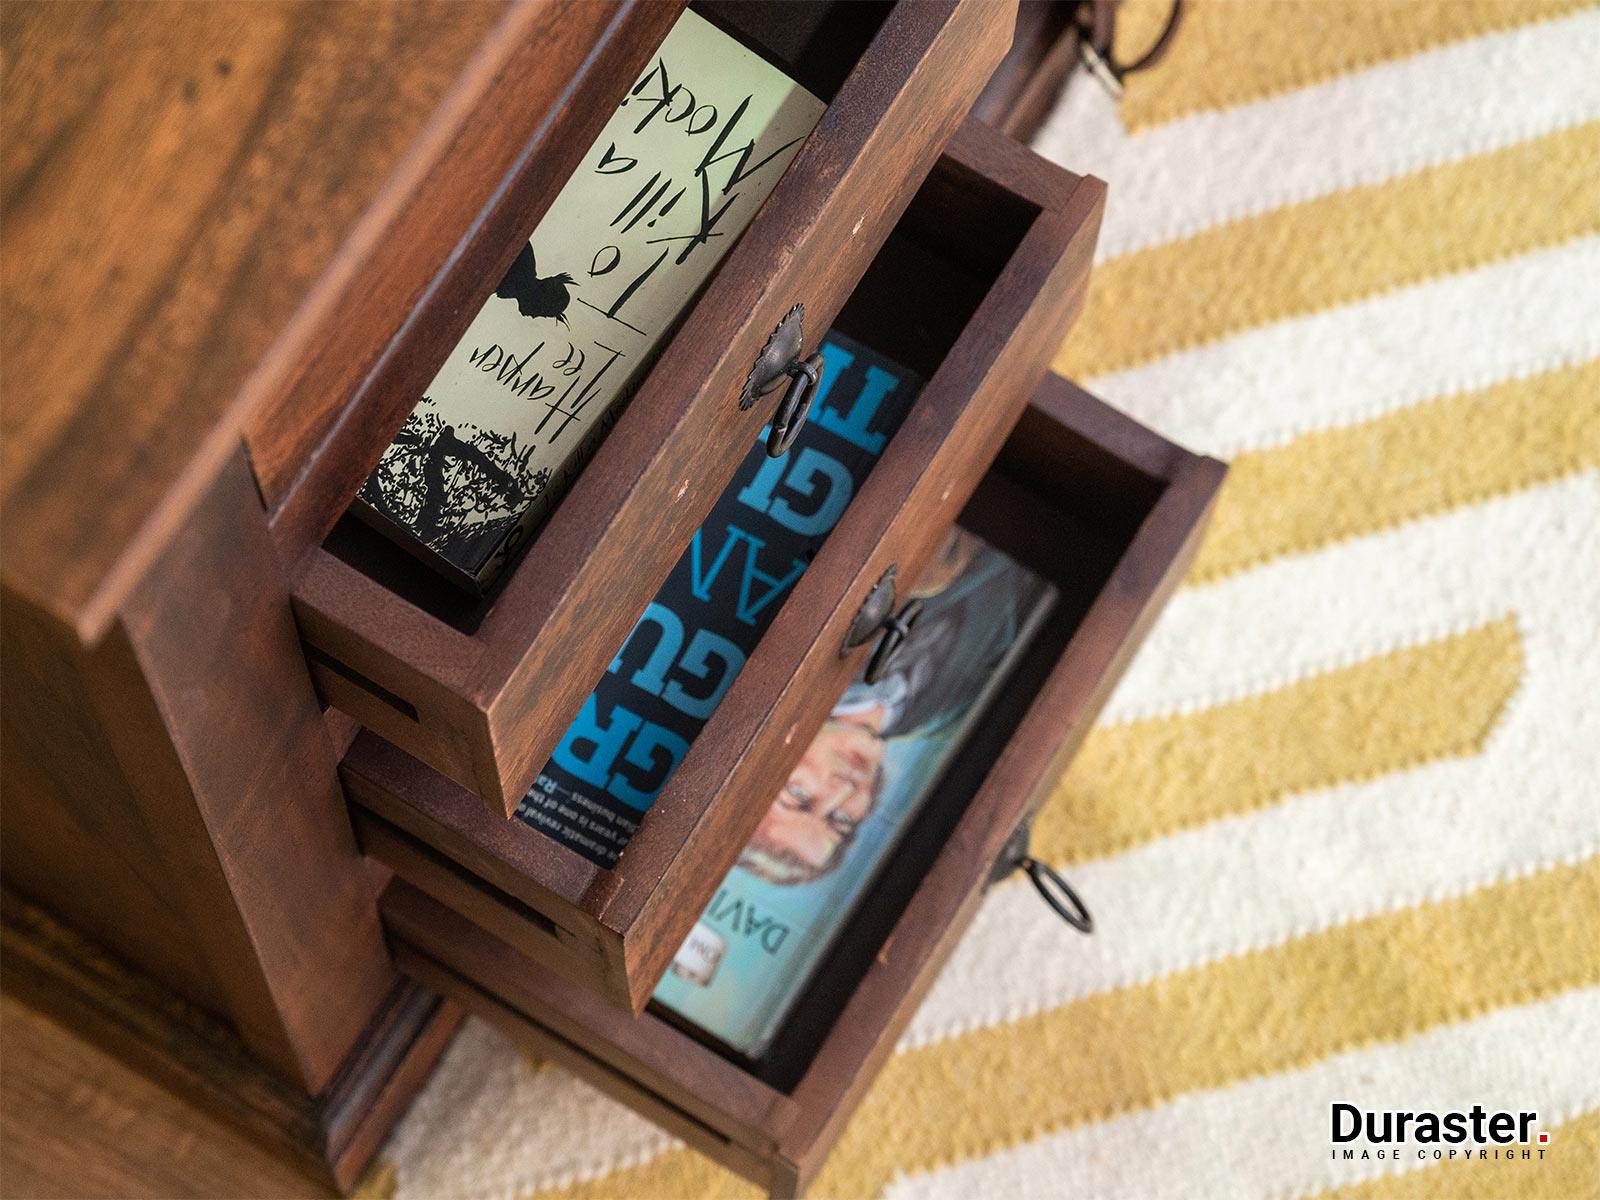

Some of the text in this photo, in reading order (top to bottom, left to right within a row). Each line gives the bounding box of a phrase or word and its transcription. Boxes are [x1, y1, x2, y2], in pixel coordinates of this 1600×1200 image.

[620, 56, 806, 195] Mocki
[594, 142, 740, 265] Kill a
[577, 245, 669, 336] To
[469, 341, 600, 444] Harper
[552, 340, 626, 408] Lee
